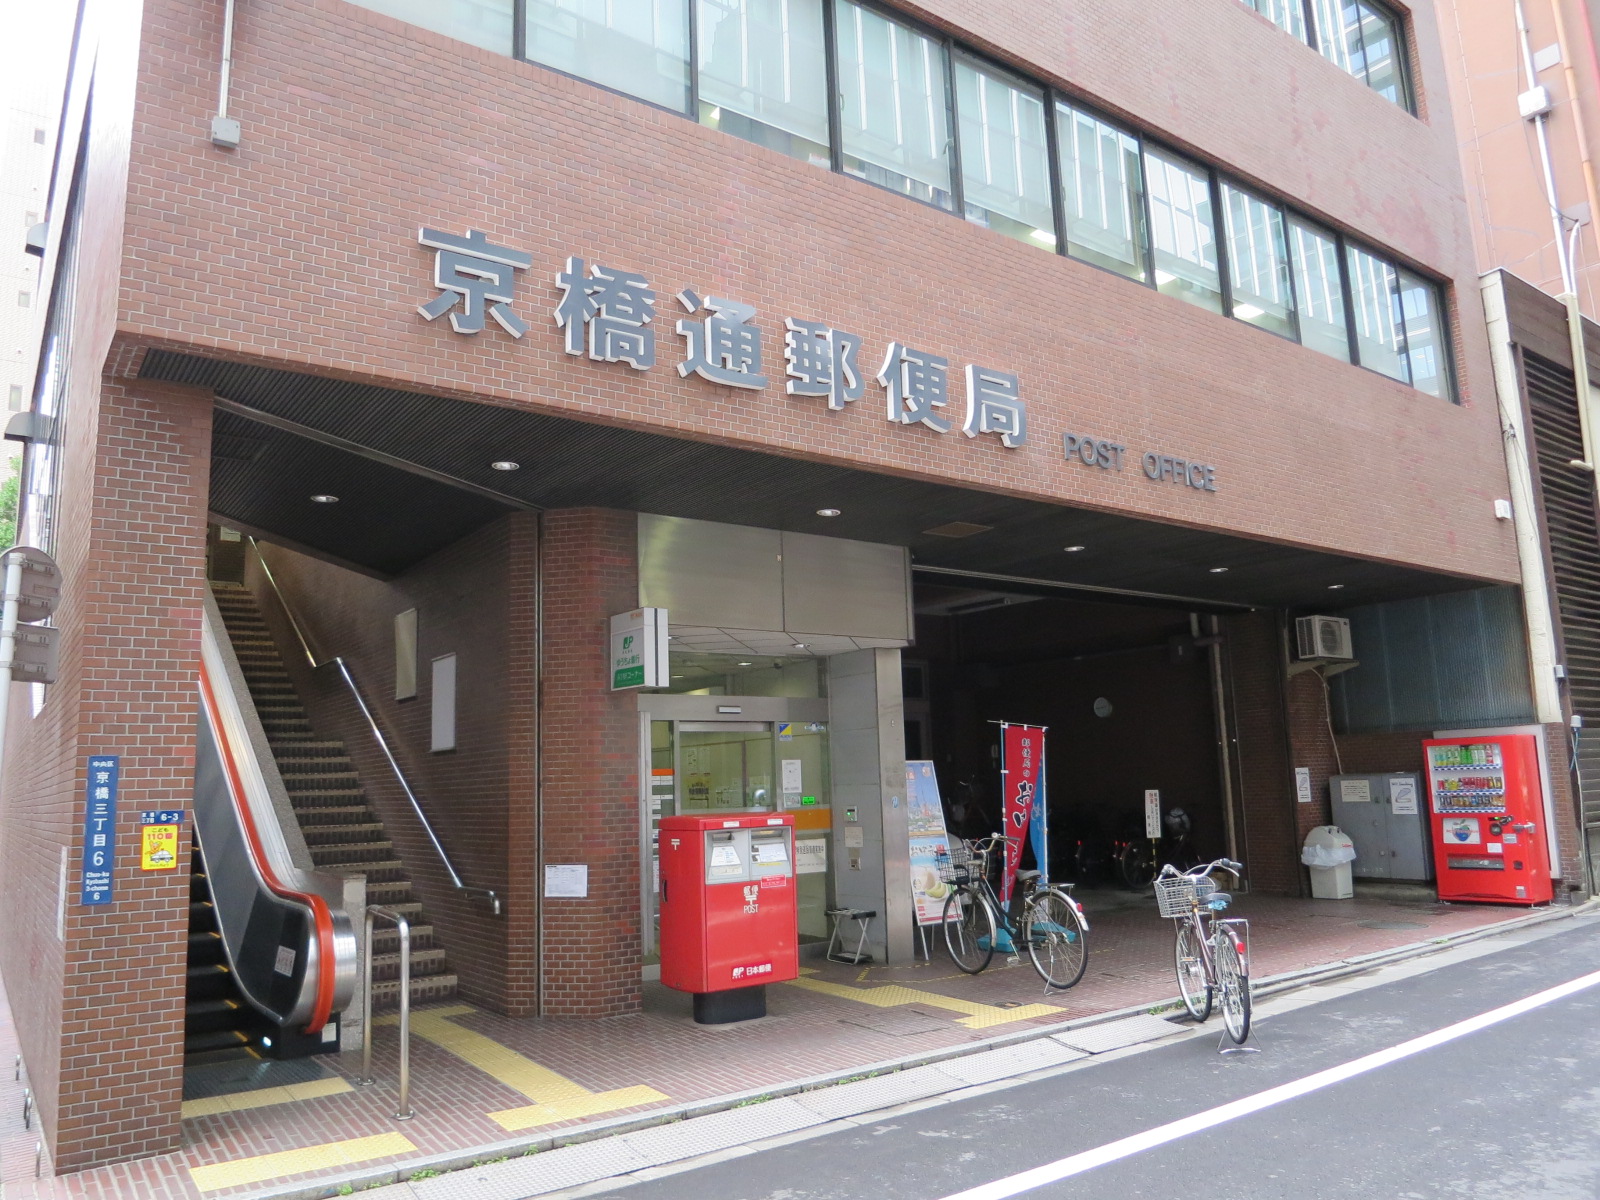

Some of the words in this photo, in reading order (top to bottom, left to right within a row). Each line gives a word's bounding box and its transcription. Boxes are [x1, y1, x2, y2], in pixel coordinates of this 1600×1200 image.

[417, 228, 1027, 449] 京橋通郵便局
[1062, 432, 1125, 471] POST
[1142, 451, 1217, 492] OFFICE
[160, 813, 179, 821] 6-3
[93, 892, 101, 901] 6
[743, 903, 759, 914] POST
